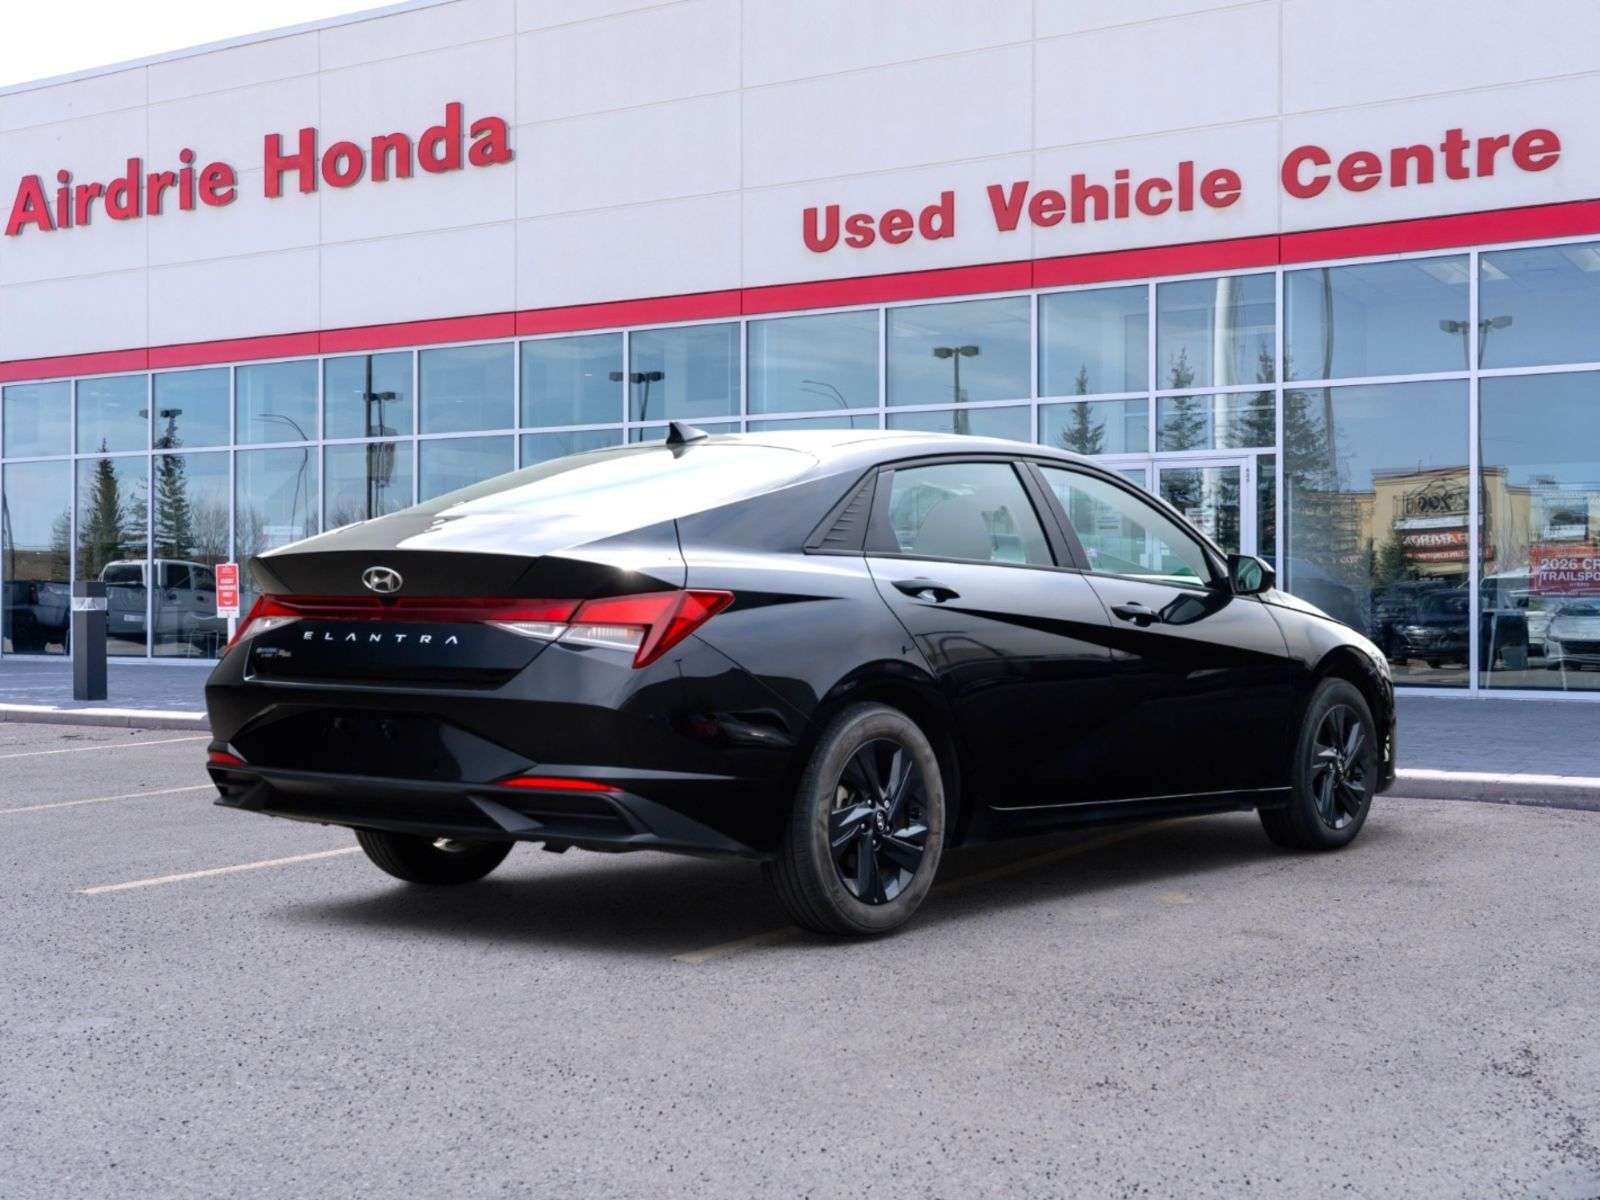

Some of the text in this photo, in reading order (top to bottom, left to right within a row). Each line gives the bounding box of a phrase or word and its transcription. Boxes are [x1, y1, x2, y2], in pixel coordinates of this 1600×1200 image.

[5, 102, 514, 236] Airdrie Honda
[803, 127, 1562, 253] Used Vehicle Centre
[1541, 558, 1578, 570] 2026
[303, 630, 459, 645] ELANTRA
